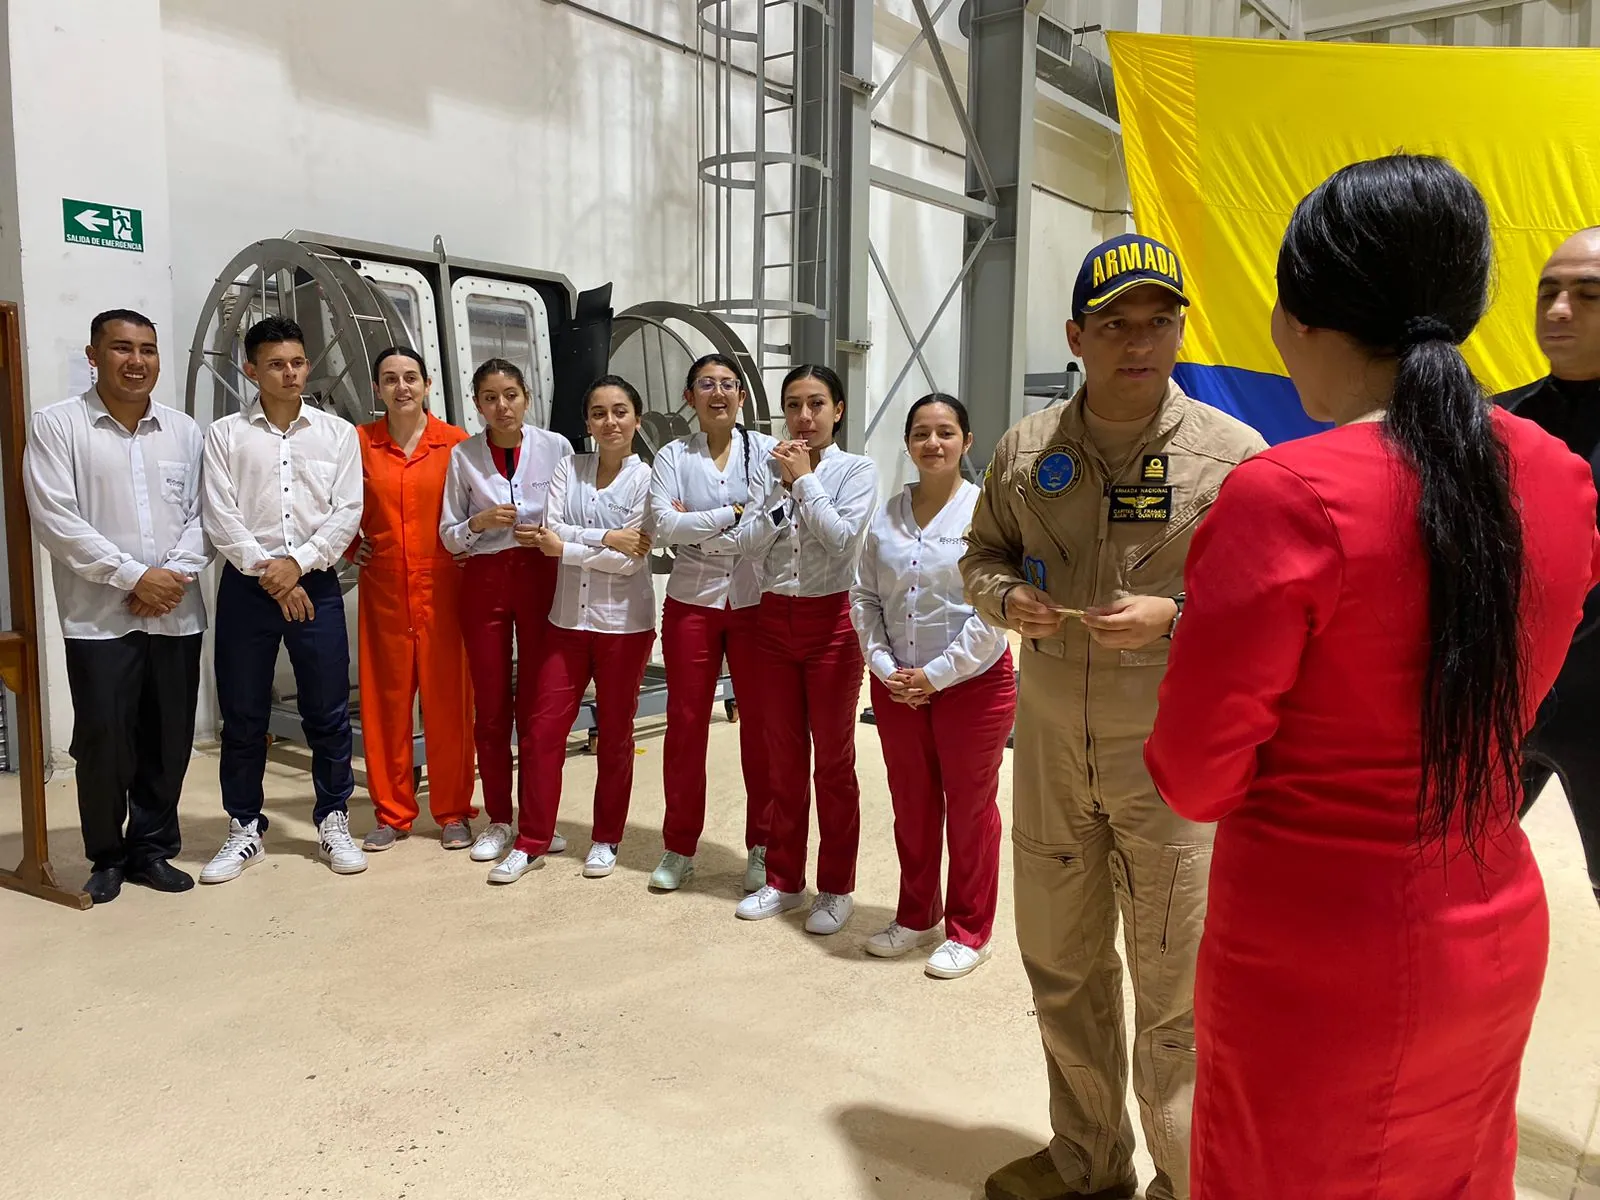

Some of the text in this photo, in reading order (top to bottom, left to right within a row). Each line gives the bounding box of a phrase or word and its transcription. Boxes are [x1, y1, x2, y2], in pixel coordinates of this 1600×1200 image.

[66, 234, 142, 250] SALIDA DE EMERGENCIA
[1093, 242, 1179, 288] ARMADA
